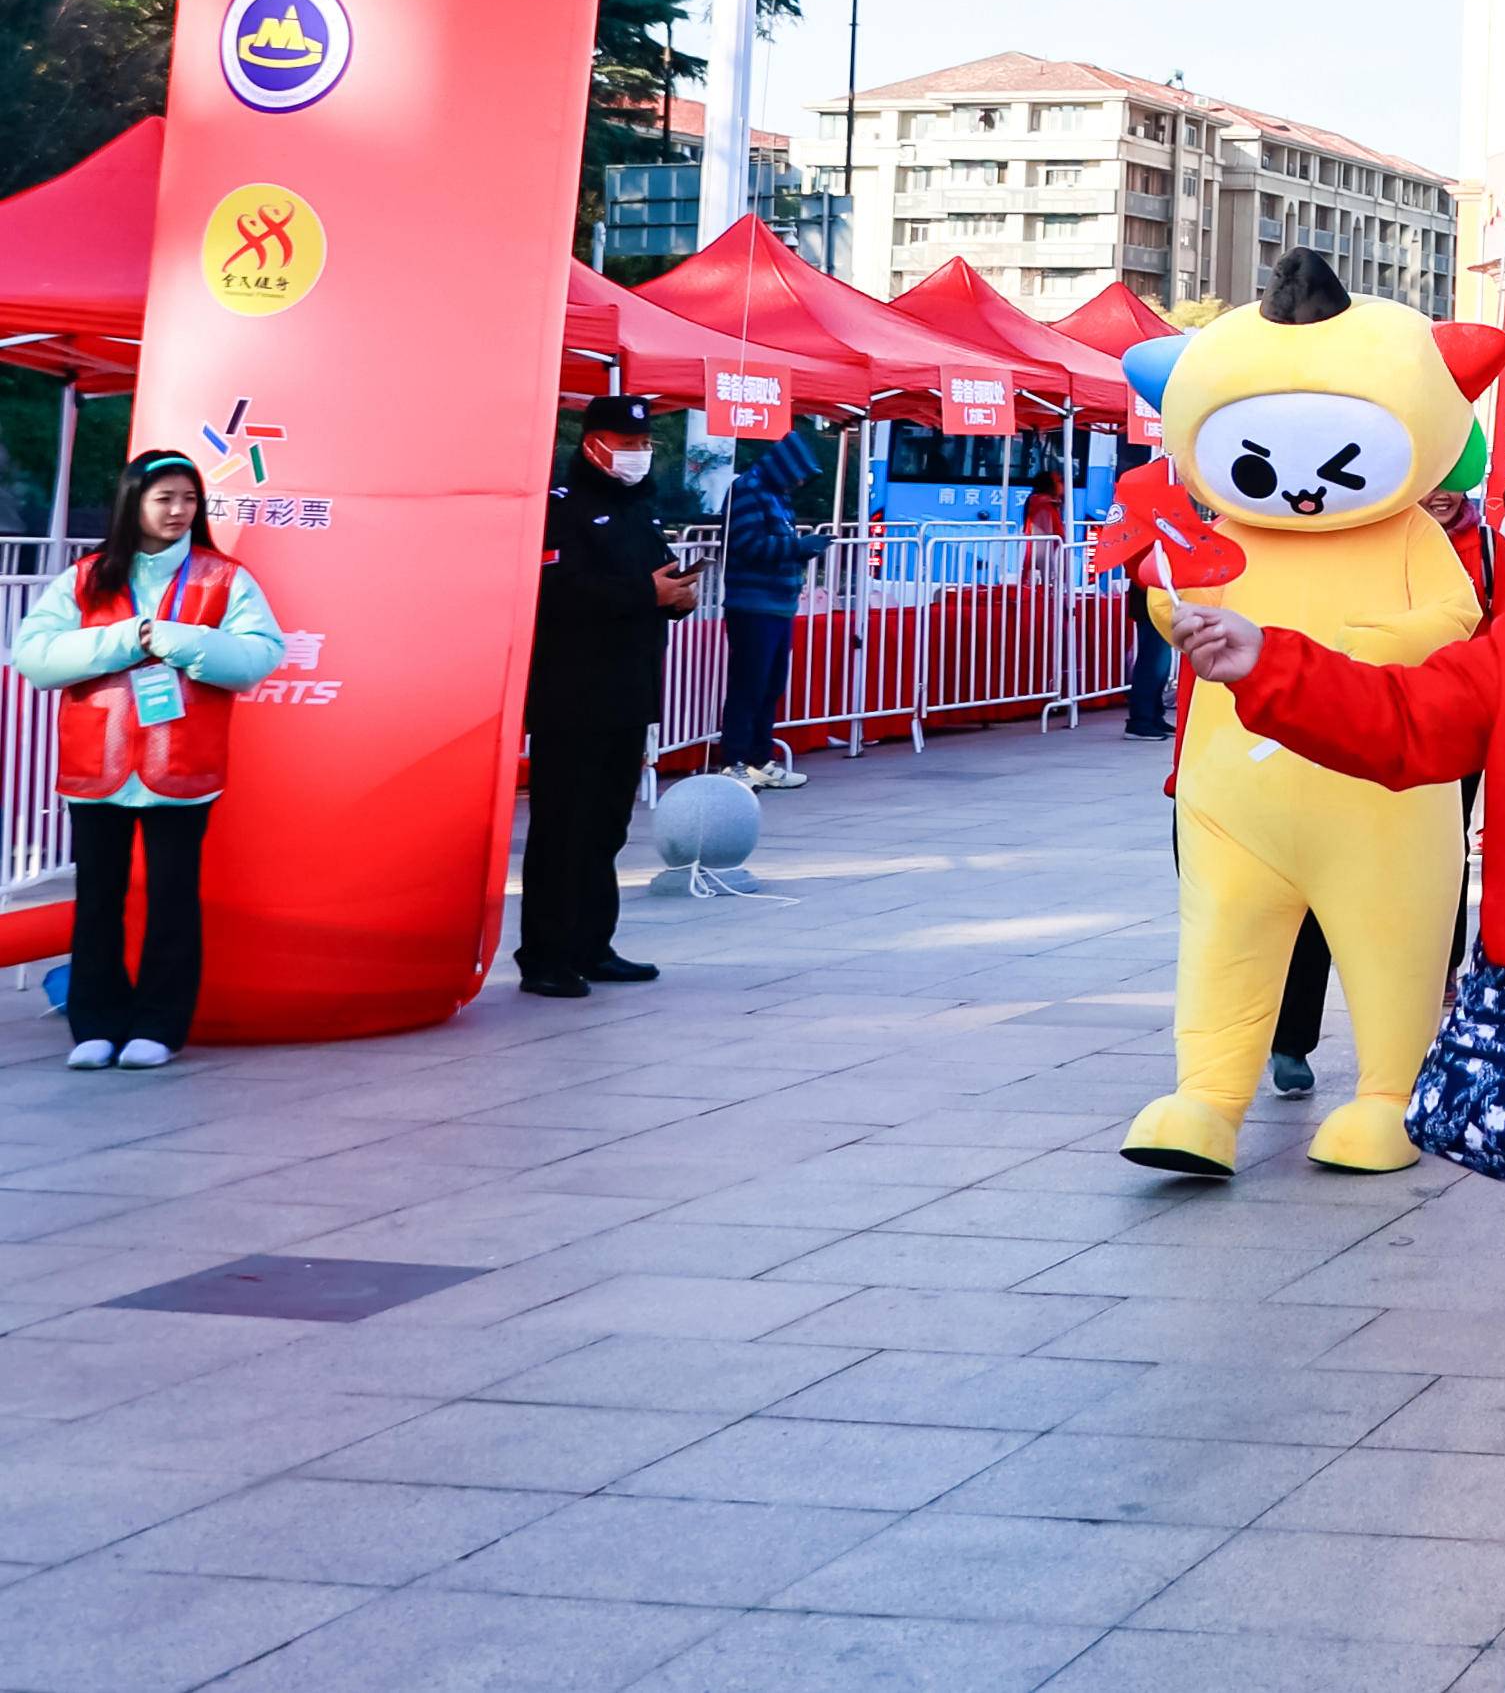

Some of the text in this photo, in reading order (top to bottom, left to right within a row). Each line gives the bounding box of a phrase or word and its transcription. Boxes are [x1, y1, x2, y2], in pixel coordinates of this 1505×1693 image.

[716, 372, 782, 405] 装备领取处
[938, 487, 1031, 507] 南京公交
